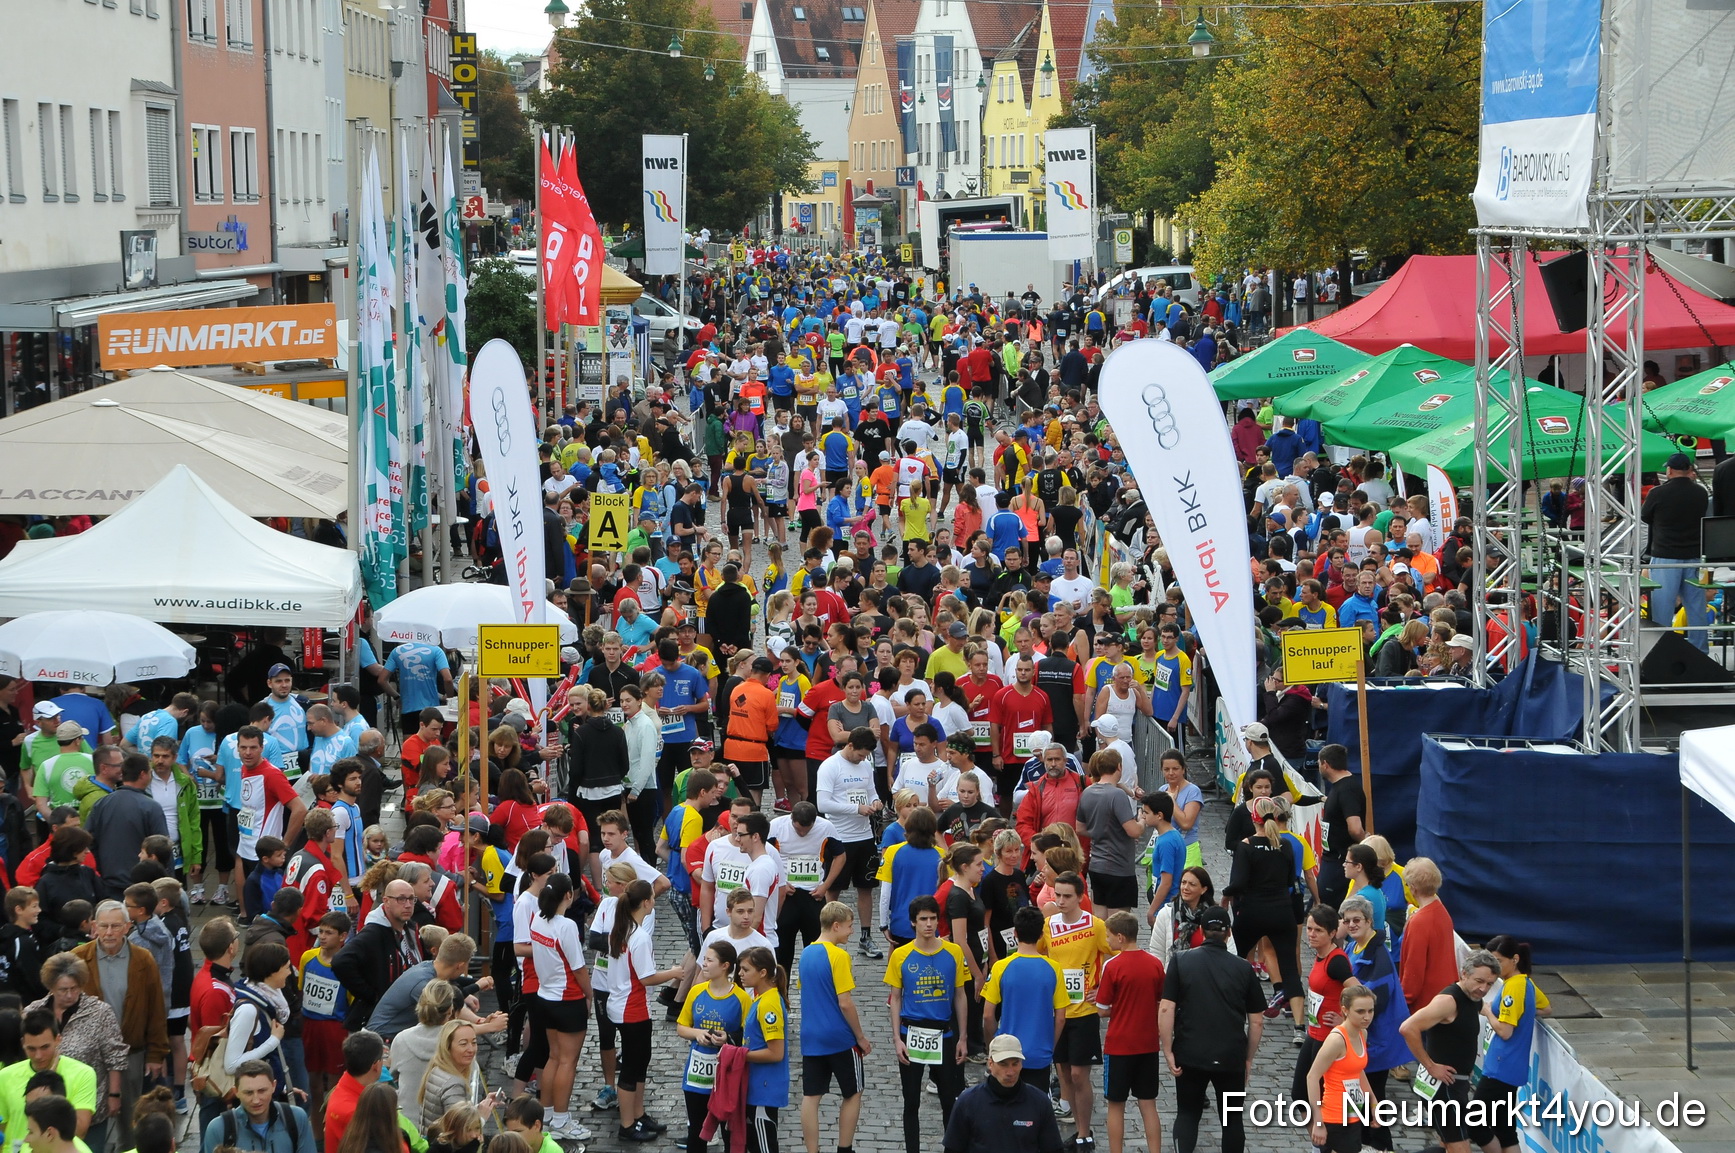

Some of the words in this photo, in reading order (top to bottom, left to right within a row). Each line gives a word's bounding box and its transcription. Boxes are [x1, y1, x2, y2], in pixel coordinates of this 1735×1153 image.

[453, 35, 477, 165] HOTEL
[1512, 153, 1556, 182] BAROWSKI
[1557, 152, 1570, 182] AG
[736, 250, 743, 259] D
[903, 250, 911, 258] D
[1278, 364, 1336, 372] Neumarkter
[1391, 411, 1443, 422] Neumarkter
[1372, 416, 1442, 430] Lammsbräu
[594, 495, 624, 507] Block
[597, 511, 619, 539] A
[154, 597, 302, 612] www.audibkk.de
[390, 630, 413, 640] Audi
[416, 631, 433, 642] BKK
[484, 639, 554, 652] Schnupper-
[1288, 644, 1357, 658] Schnupper-
[508, 653, 531, 664] lauf
[1311, 659, 1334, 671] lauf
[37, 668, 69, 679] Audi
[73, 670, 100, 683] BKK
[605, 712, 622, 723] 045
[974, 727, 991, 738] 121
[720, 867, 745, 881] 5191
[790, 863, 817, 873] 5114
[1051, 936, 1070, 948] MAX
[1072, 930, 1095, 943] BÖGL
[304, 982, 333, 1001] 4053
[307, 1000, 322, 1009] David
[910, 1034, 939, 1050] 5555
